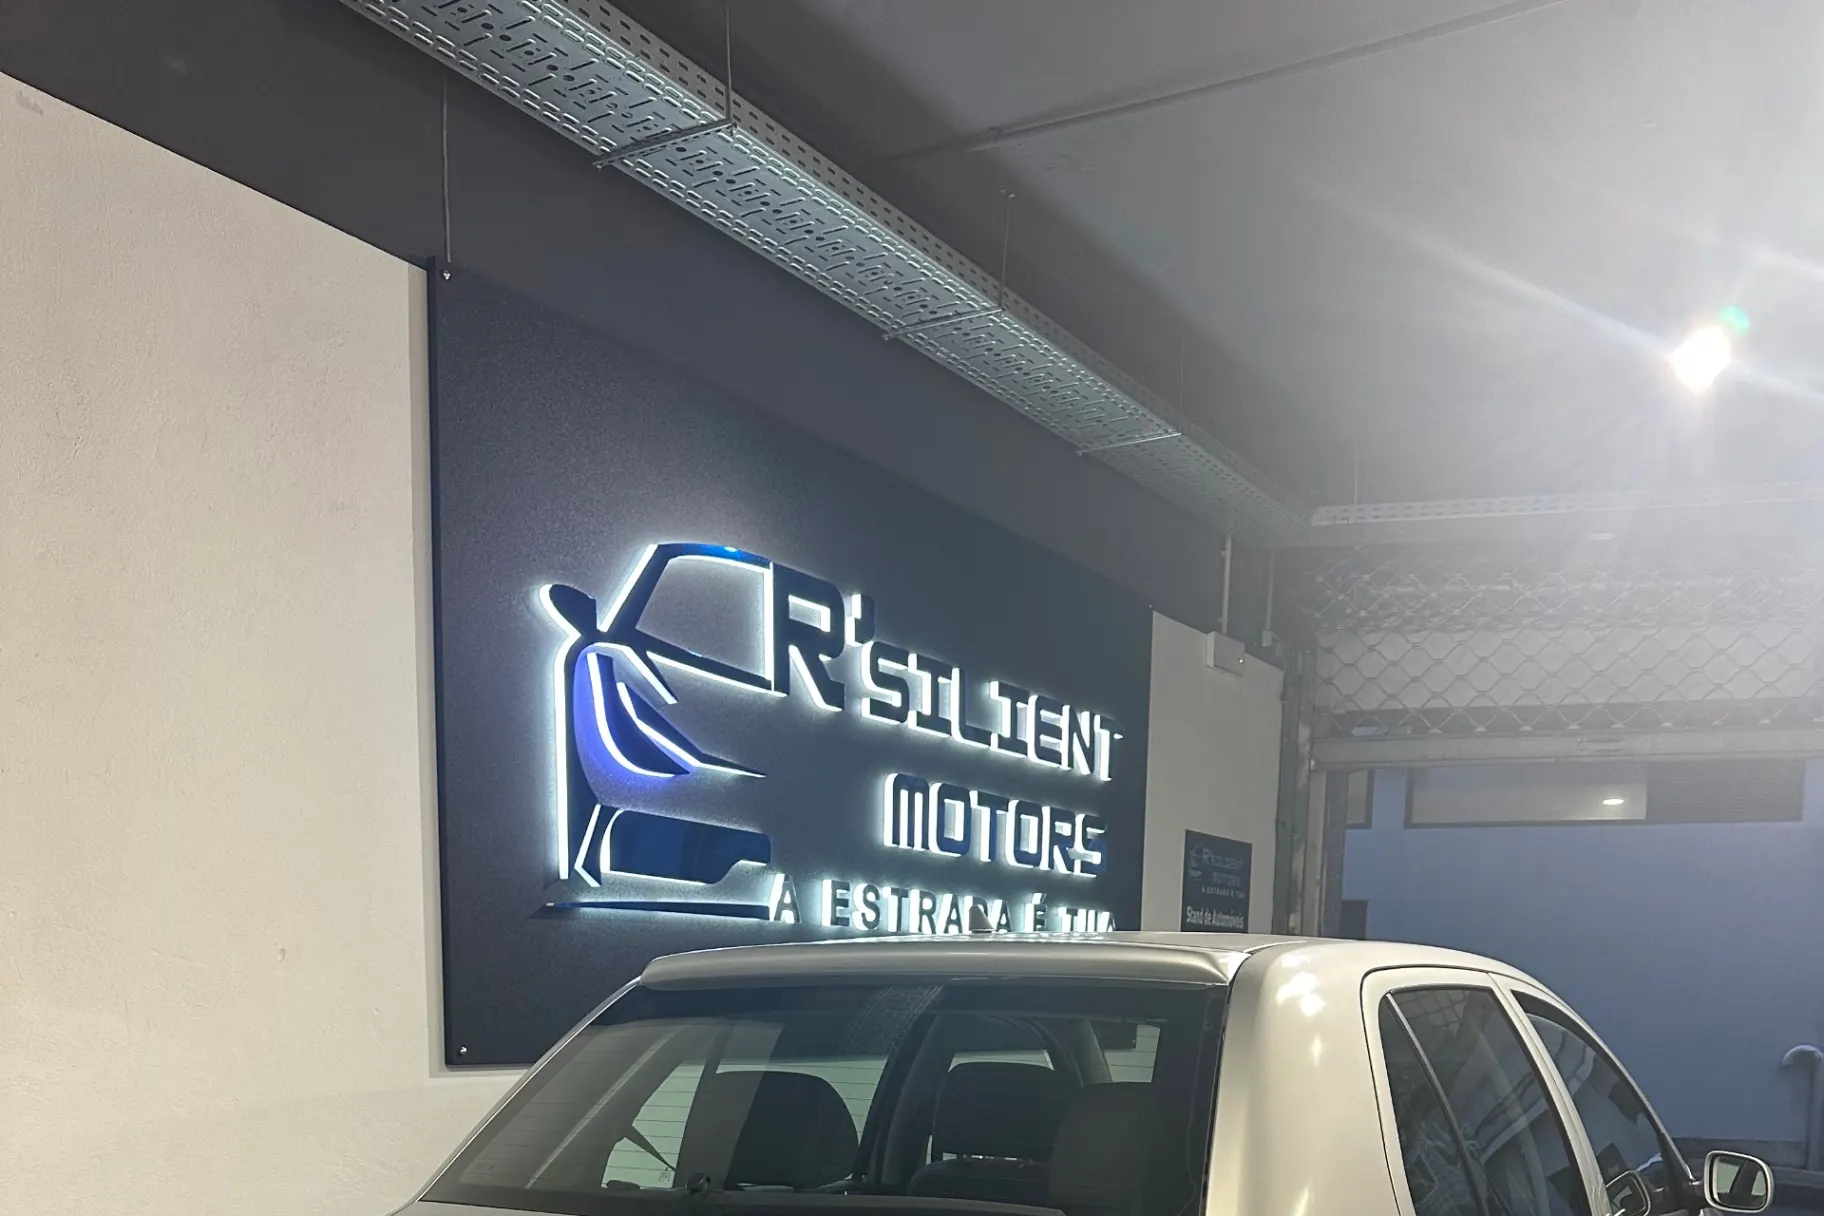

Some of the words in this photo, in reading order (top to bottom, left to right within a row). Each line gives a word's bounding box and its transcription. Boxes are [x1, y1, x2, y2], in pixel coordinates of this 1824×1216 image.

[766, 561, 1123, 782] R'SILIENT
[883, 772, 1107, 878] MOTORS
[770, 873, 802, 924] A
[1024, 892, 1048, 933] É
